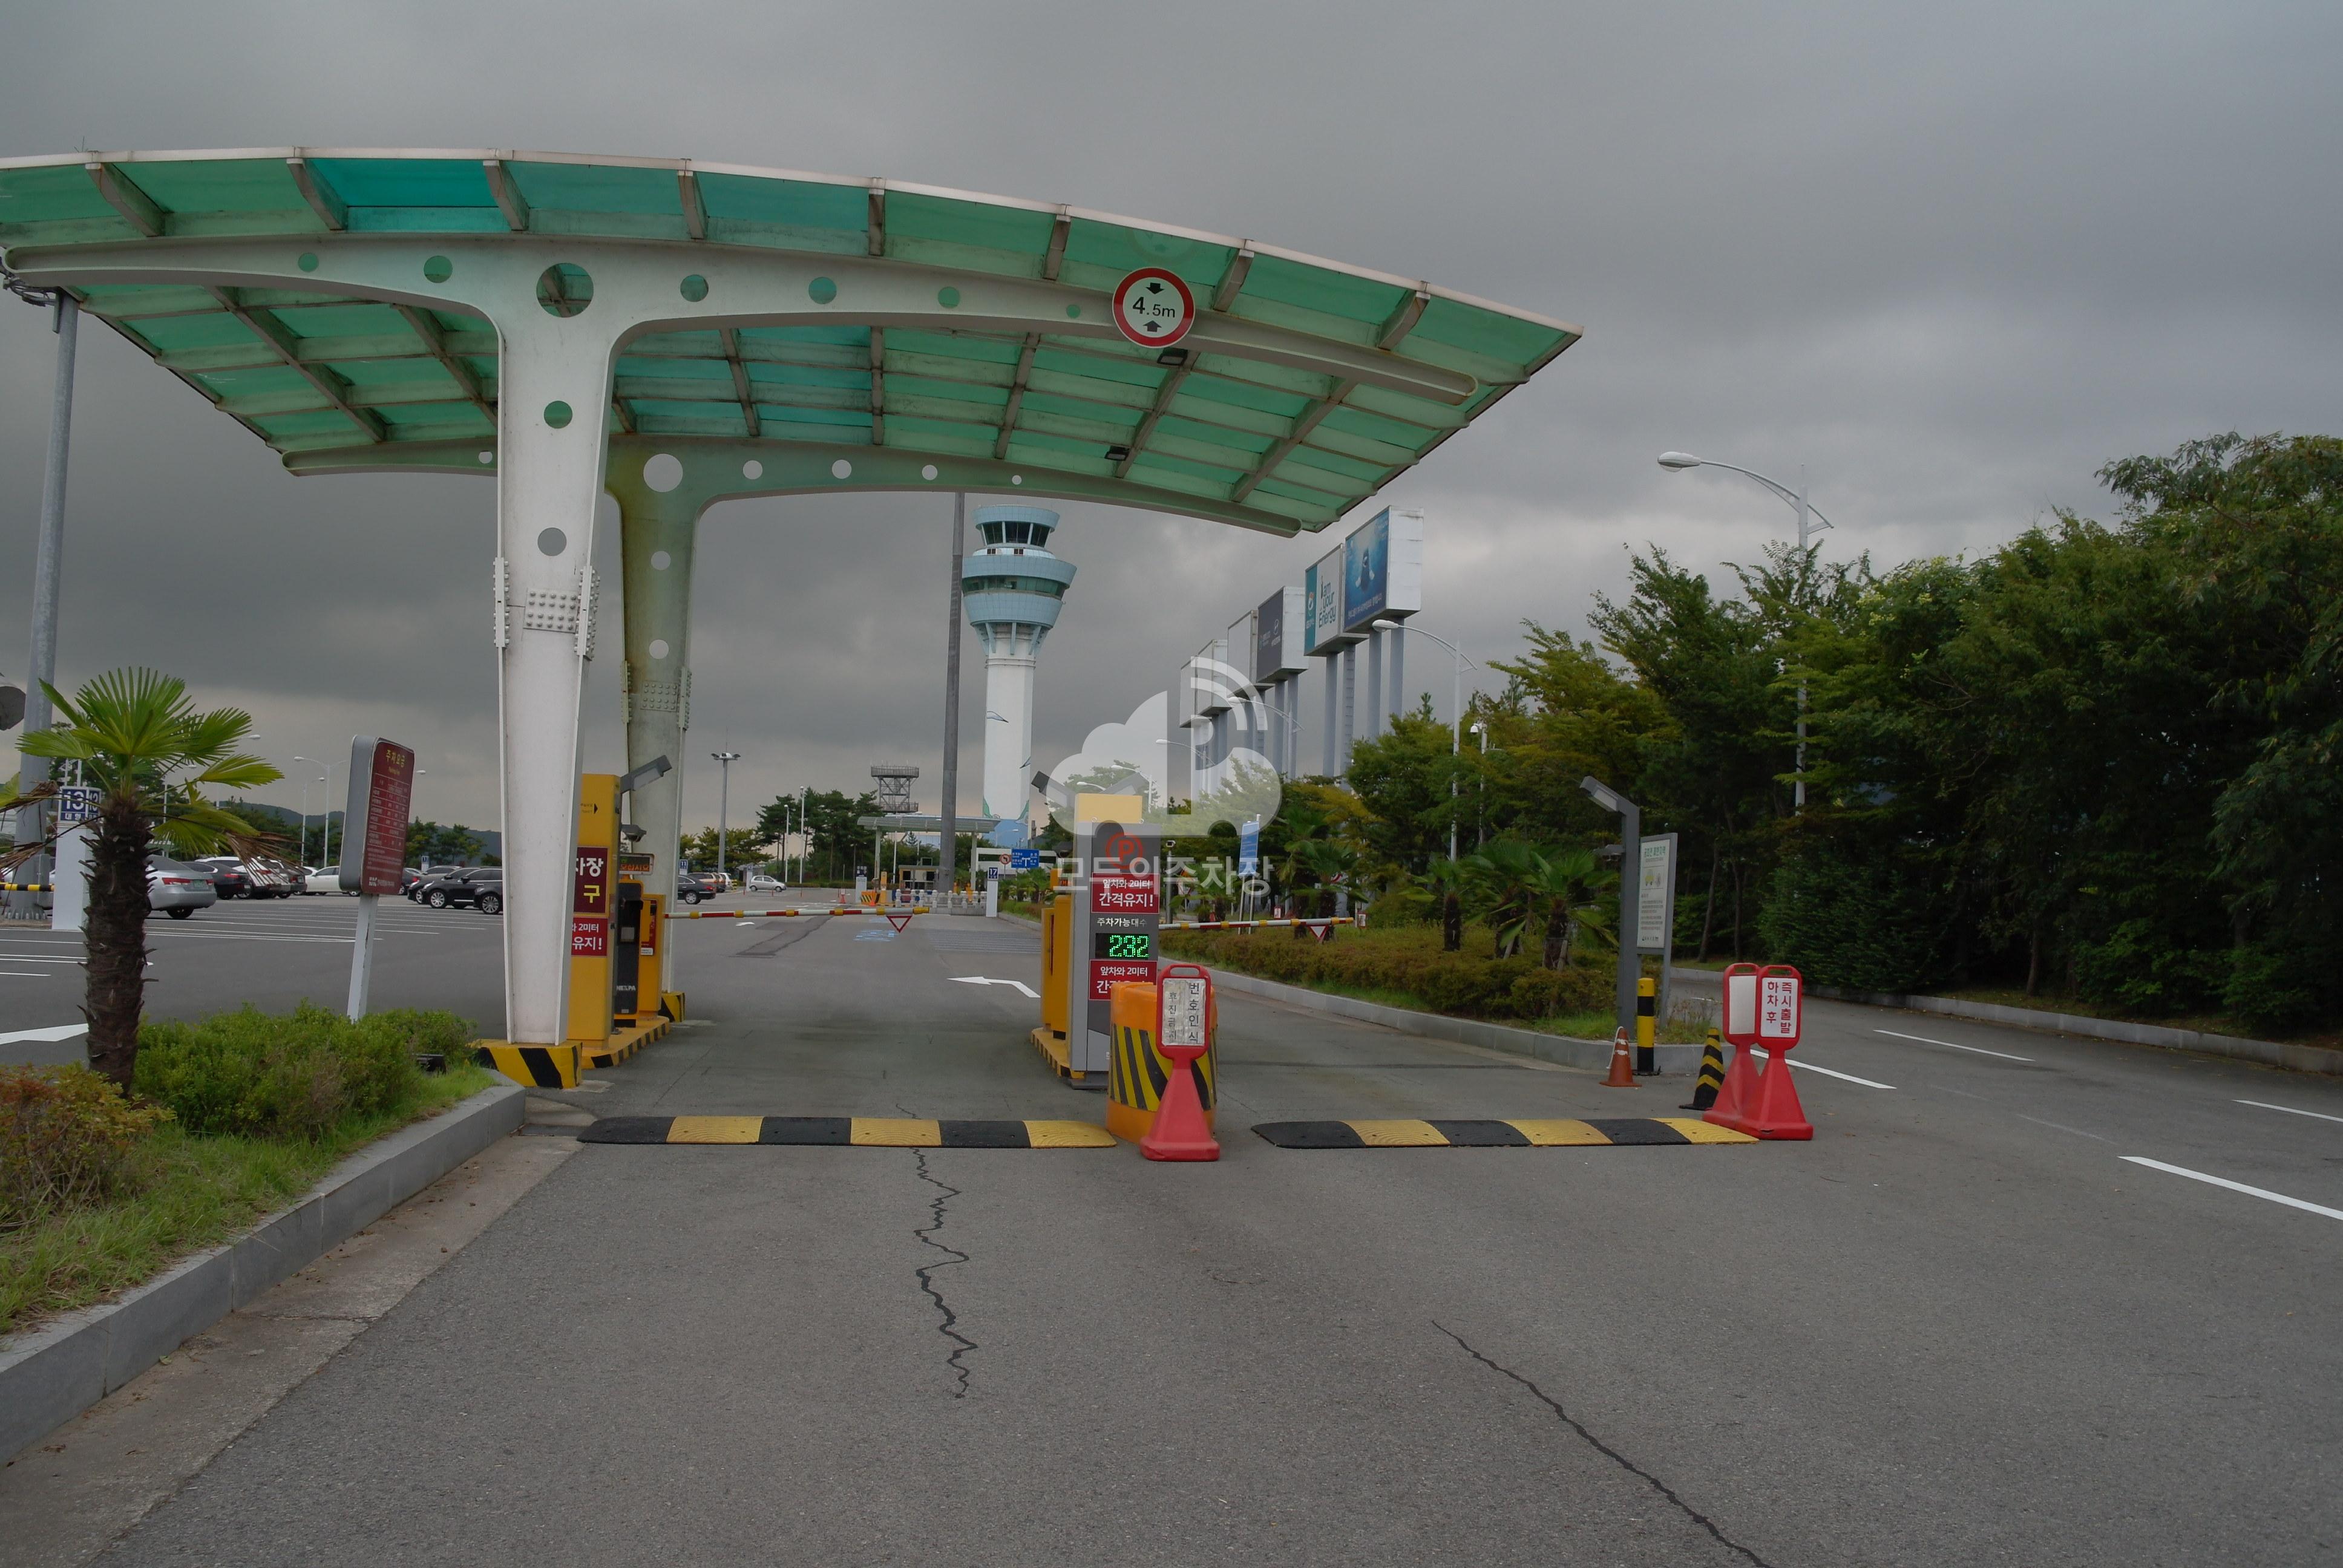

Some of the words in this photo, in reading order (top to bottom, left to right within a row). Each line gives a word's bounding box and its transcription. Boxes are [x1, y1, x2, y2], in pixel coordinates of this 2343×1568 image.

[1132, 296, 1176, 318] 4.5m
[1319, 606, 1337, 629] Energy
[385, 750, 405, 768] 주차요금
[64, 791, 85, 811] 13
[1118, 840, 1134, 863] P
[583, 884, 600, 904] 구
[1103, 879, 1127, 889] 앞차와
[1129, 880, 1150, 890] 2미터
[1099, 892, 1154, 907] 간격유지!
[578, 923, 599, 933] 2미터
[1096, 917, 1148, 928] 주차가능대수
[1109, 935, 1150, 958] 232
[1100, 966, 1126, 976] 앞차와
[1127, 967, 1149, 976] 2미터
[1188, 982, 1200, 1044] 번호인식
[1780, 982, 1792, 1034] 즉시출발
